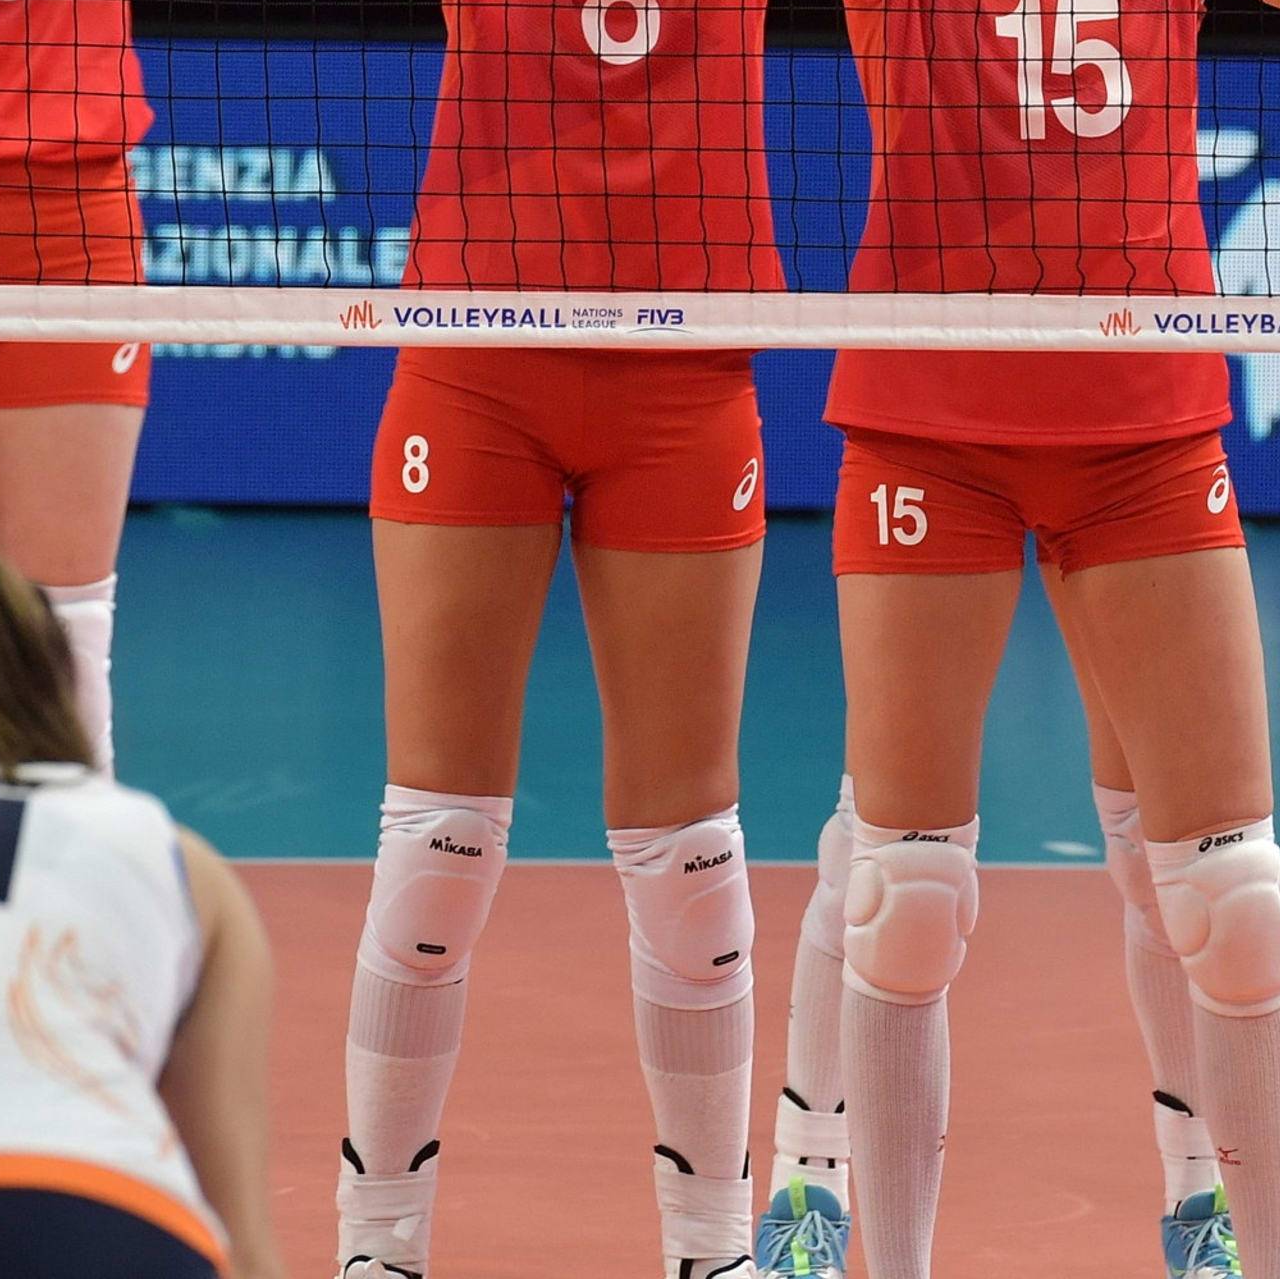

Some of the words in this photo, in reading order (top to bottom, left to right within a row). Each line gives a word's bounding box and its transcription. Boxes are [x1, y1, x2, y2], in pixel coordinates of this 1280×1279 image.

[394, 307, 567, 328] VOLLEYBALL
[572, 308, 624, 318] NATIONS
[637, 308, 684, 325] FIVB
[572, 320, 617, 329] LEAGUE
[402, 435, 430, 494] 8
[870, 484, 928, 546] 15
